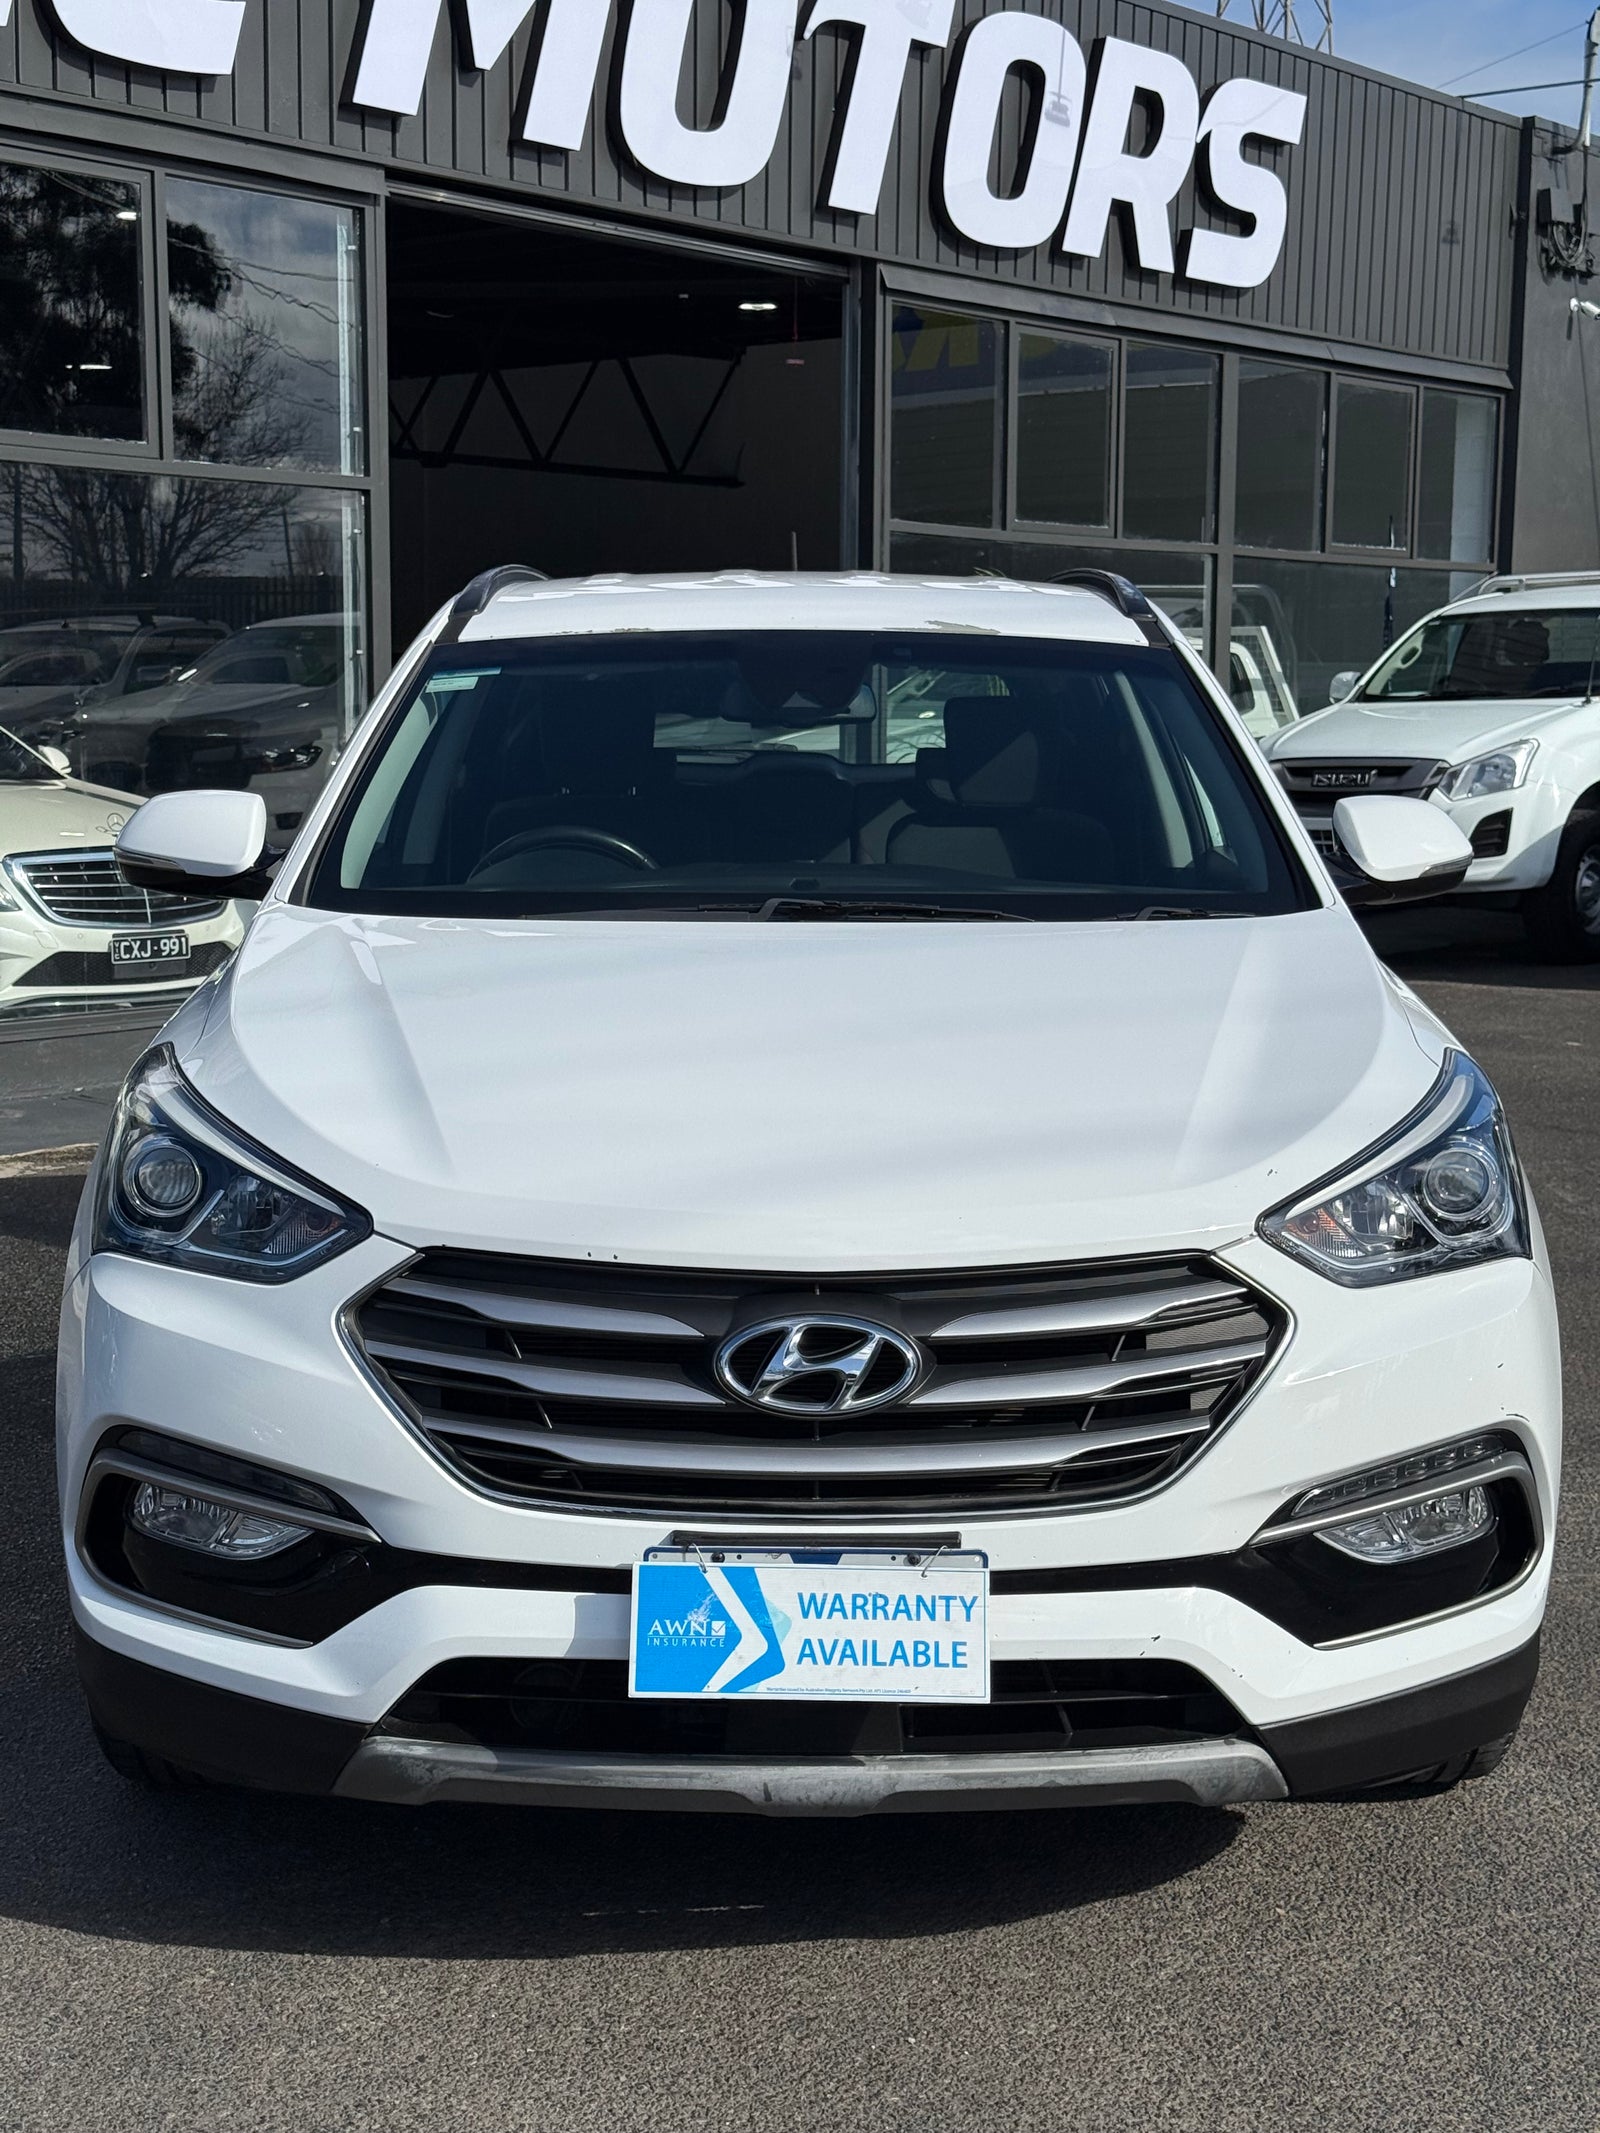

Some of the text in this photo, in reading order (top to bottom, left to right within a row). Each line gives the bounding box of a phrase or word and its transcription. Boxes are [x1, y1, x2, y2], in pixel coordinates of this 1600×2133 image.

[352, 0, 1307, 288] MOTORS
[1312, 771, 1371, 787] ISUZU
[797, 1592, 979, 1622] WARRANTY
[647, 1618, 711, 1636] AWN
[647, 1637, 725, 1648] INSURANCE
[796, 1638, 968, 1668] AVAILABLE
